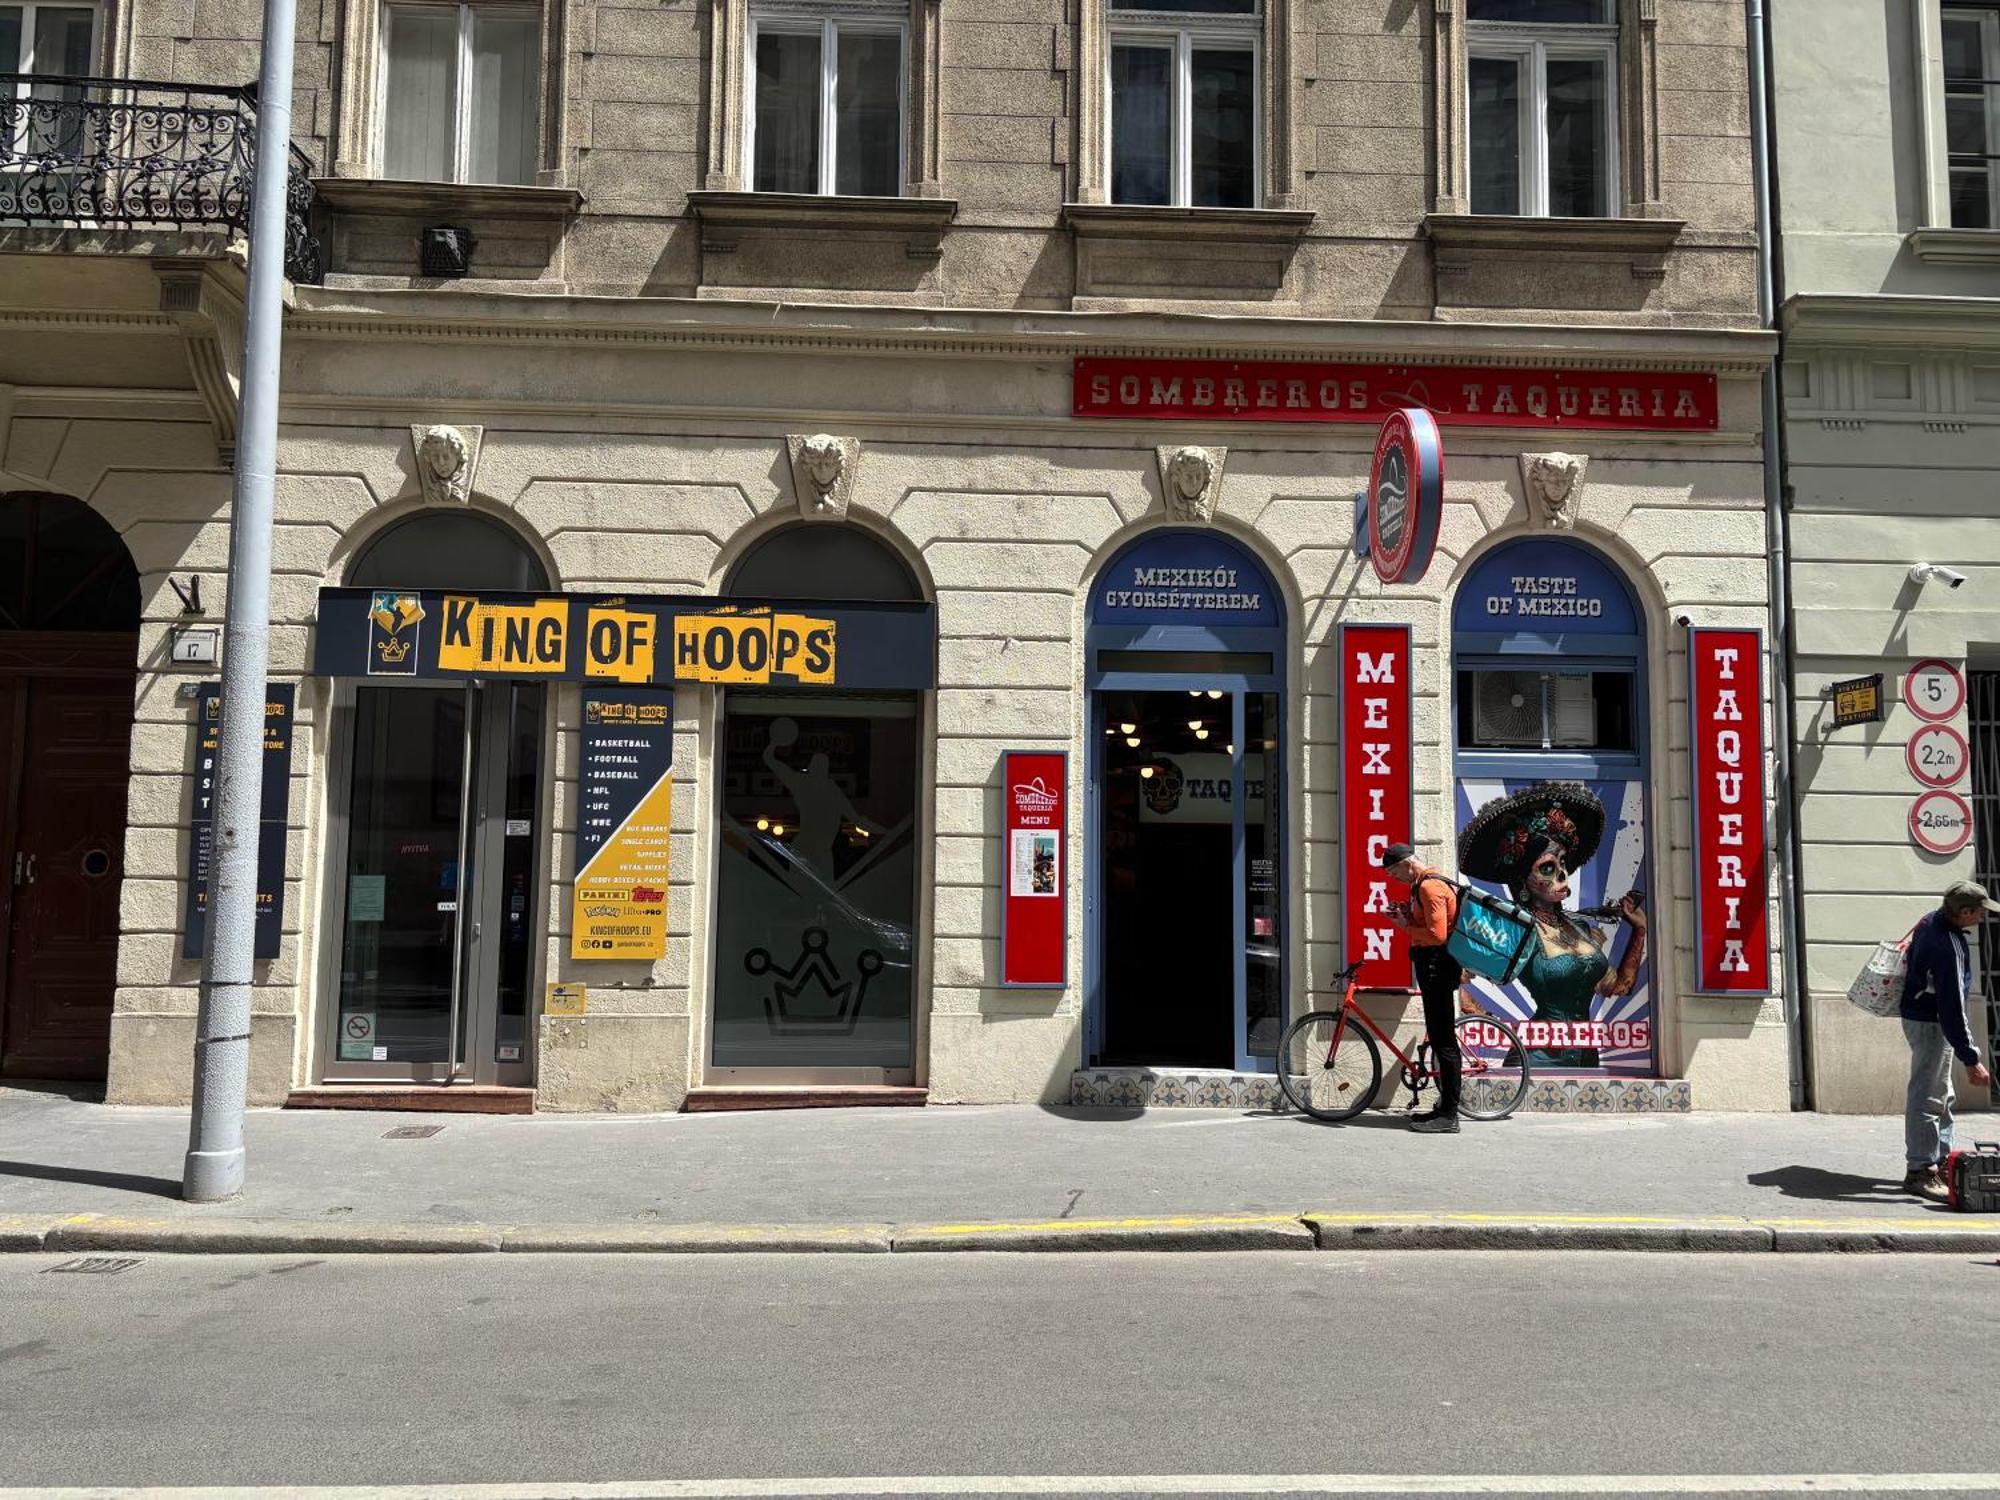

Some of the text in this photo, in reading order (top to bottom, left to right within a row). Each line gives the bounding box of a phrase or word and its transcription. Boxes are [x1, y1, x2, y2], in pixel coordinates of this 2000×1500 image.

[1091, 374, 1700, 418] SOMBREROS TAQUERIA
[1134, 565, 1237, 588] MEXIKÓI
[1511, 576, 1577, 595] TASTE
[1106, 588, 1260, 609] GYORSÉTTEREM
[1486, 597, 1602, 616] OF MEXICO
[444, 600, 831, 674] KING OF HOOPS
[187, 643, 200, 658] 17
[1927, 678, 1942, 702] 5
[265, 704, 285, 715] OOPS
[625, 705, 637, 717] OF
[264, 741, 285, 749] TORE
[592, 803, 610, 811] UFC
[1356, 652, 1395, 960] MEXICAN
[1713, 649, 1749, 972] TAQUERIA
[592, 818, 612, 826] WWE
[1021, 816, 1050, 825] MENU
[591, 834, 601, 843] F1
[582, 891, 626, 899] PANINI
[1463, 1021, 1649, 1048] SOMBREROS
